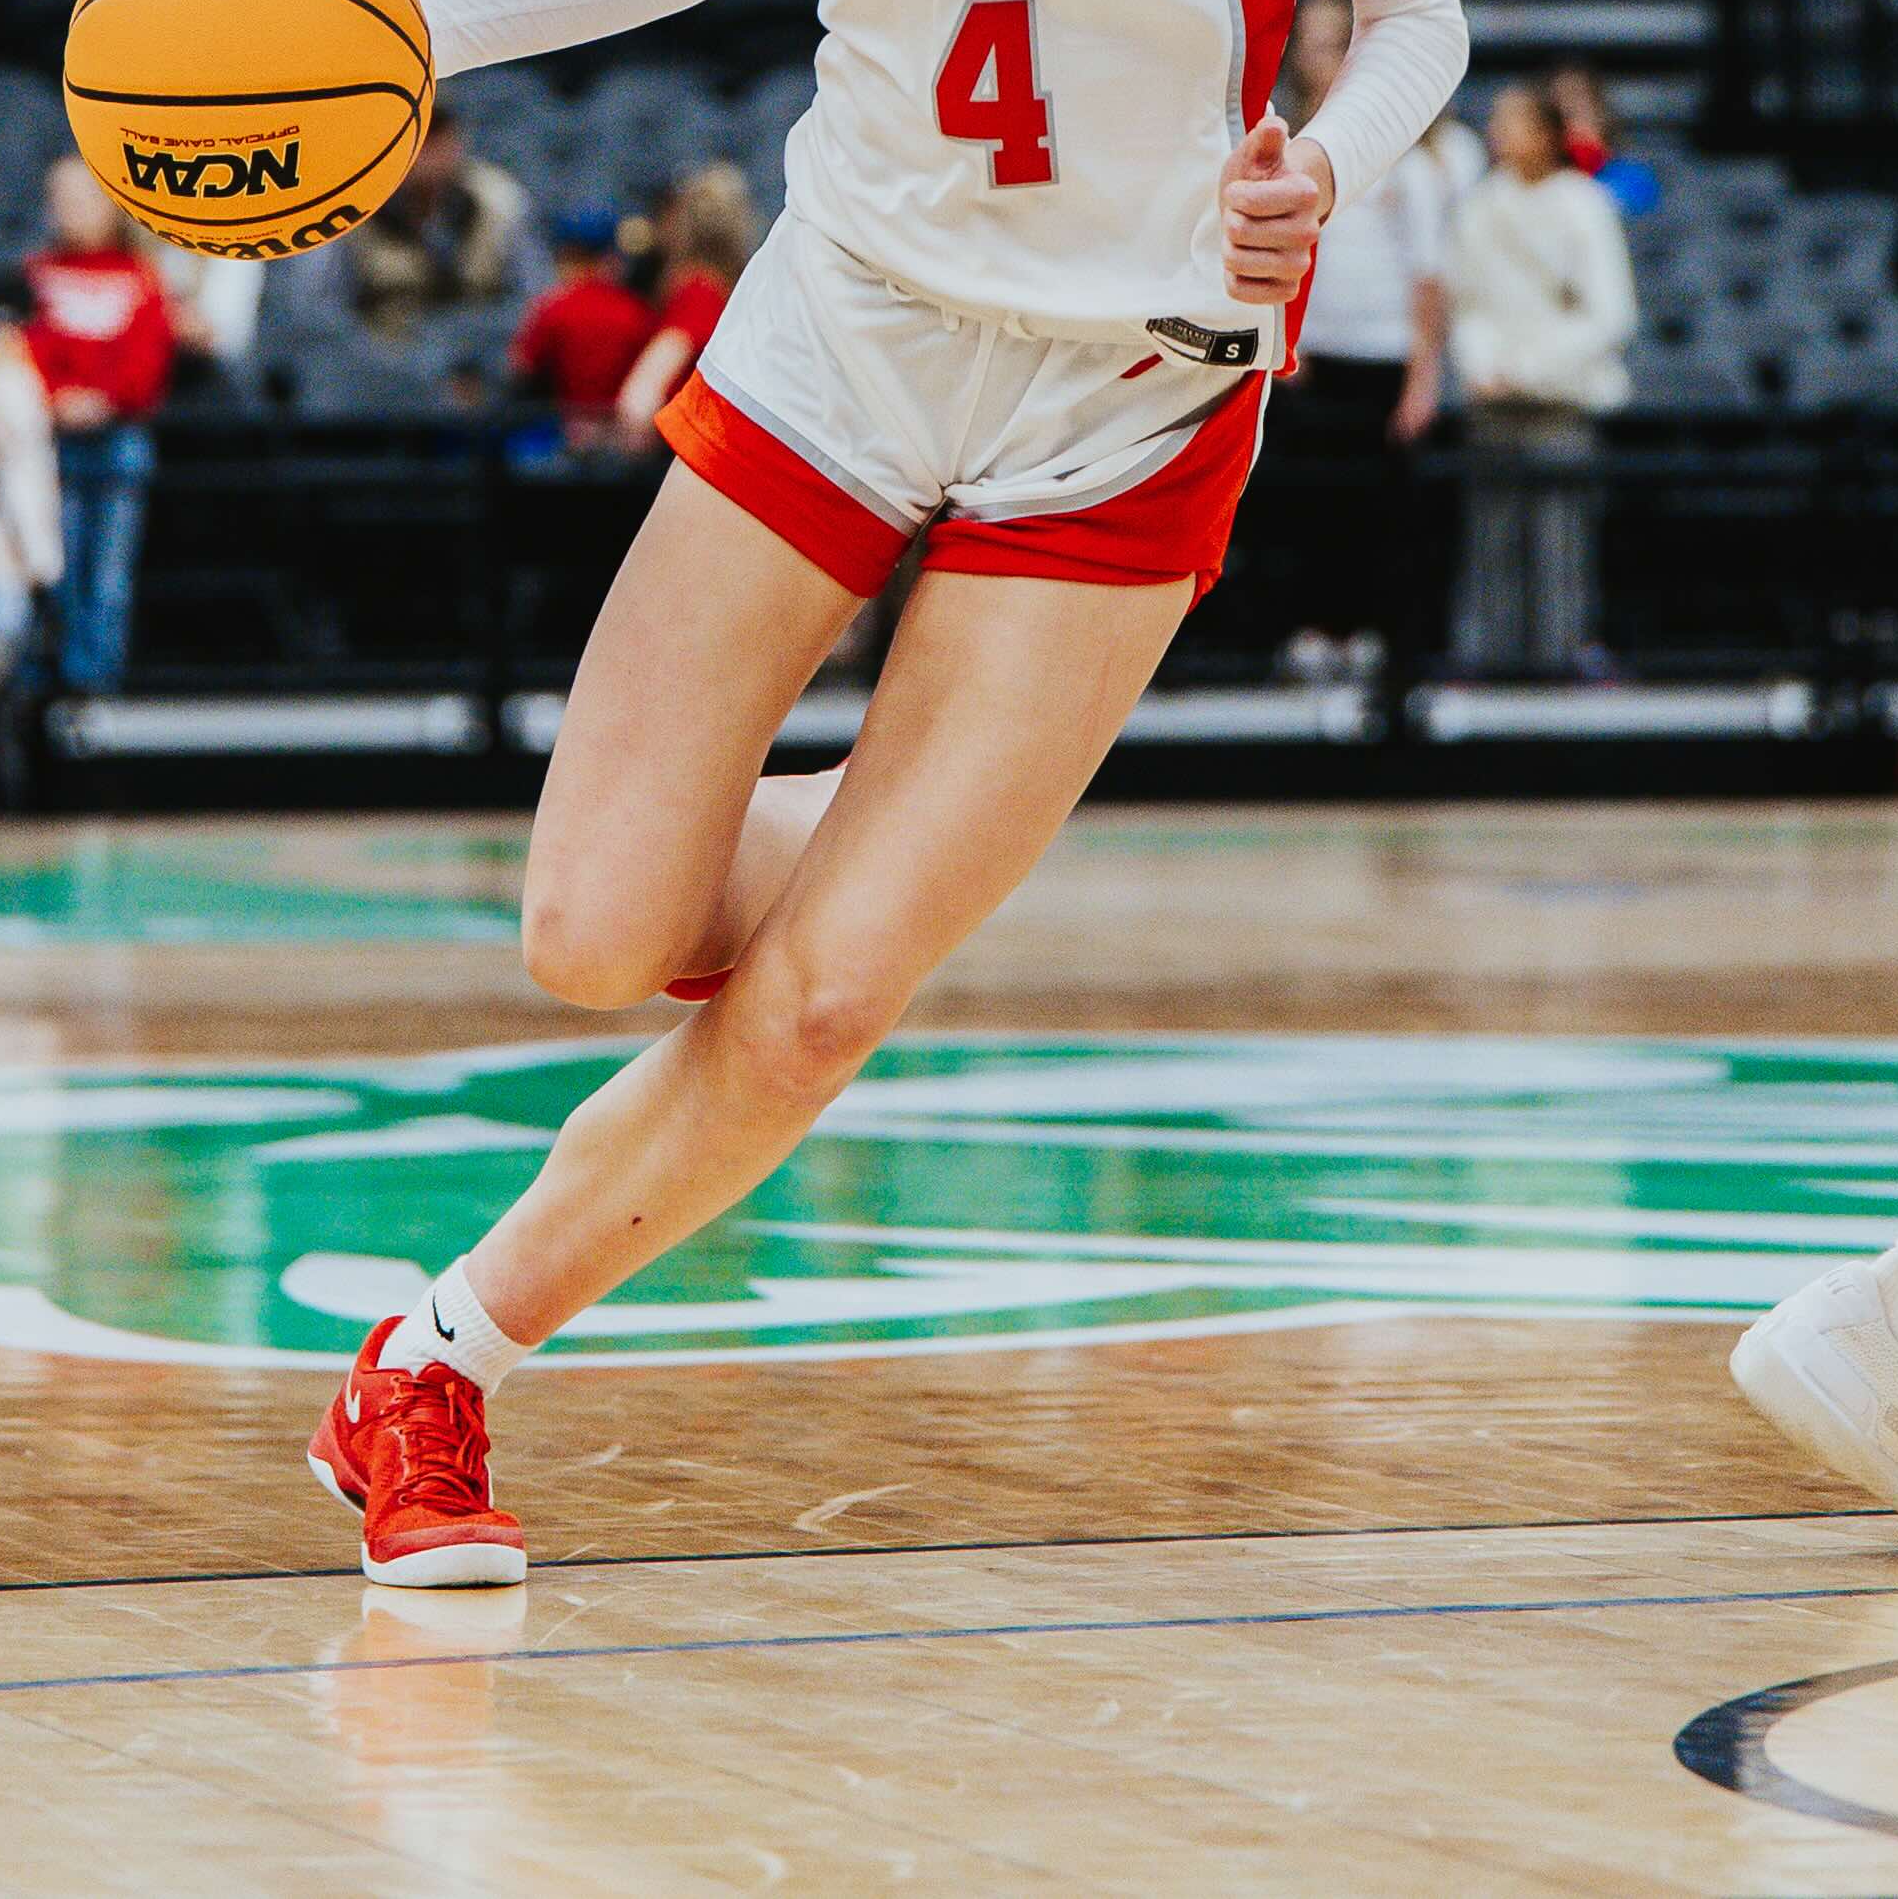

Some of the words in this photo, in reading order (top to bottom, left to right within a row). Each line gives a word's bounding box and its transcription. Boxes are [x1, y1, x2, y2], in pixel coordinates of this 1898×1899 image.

[119, 126, 161, 147] BALL
[164, 136, 216, 149] GAME
[218, 124, 300, 147] OFFICIAL
[122, 140, 301, 199] NCAA
[1225, 343, 1240, 359] S
